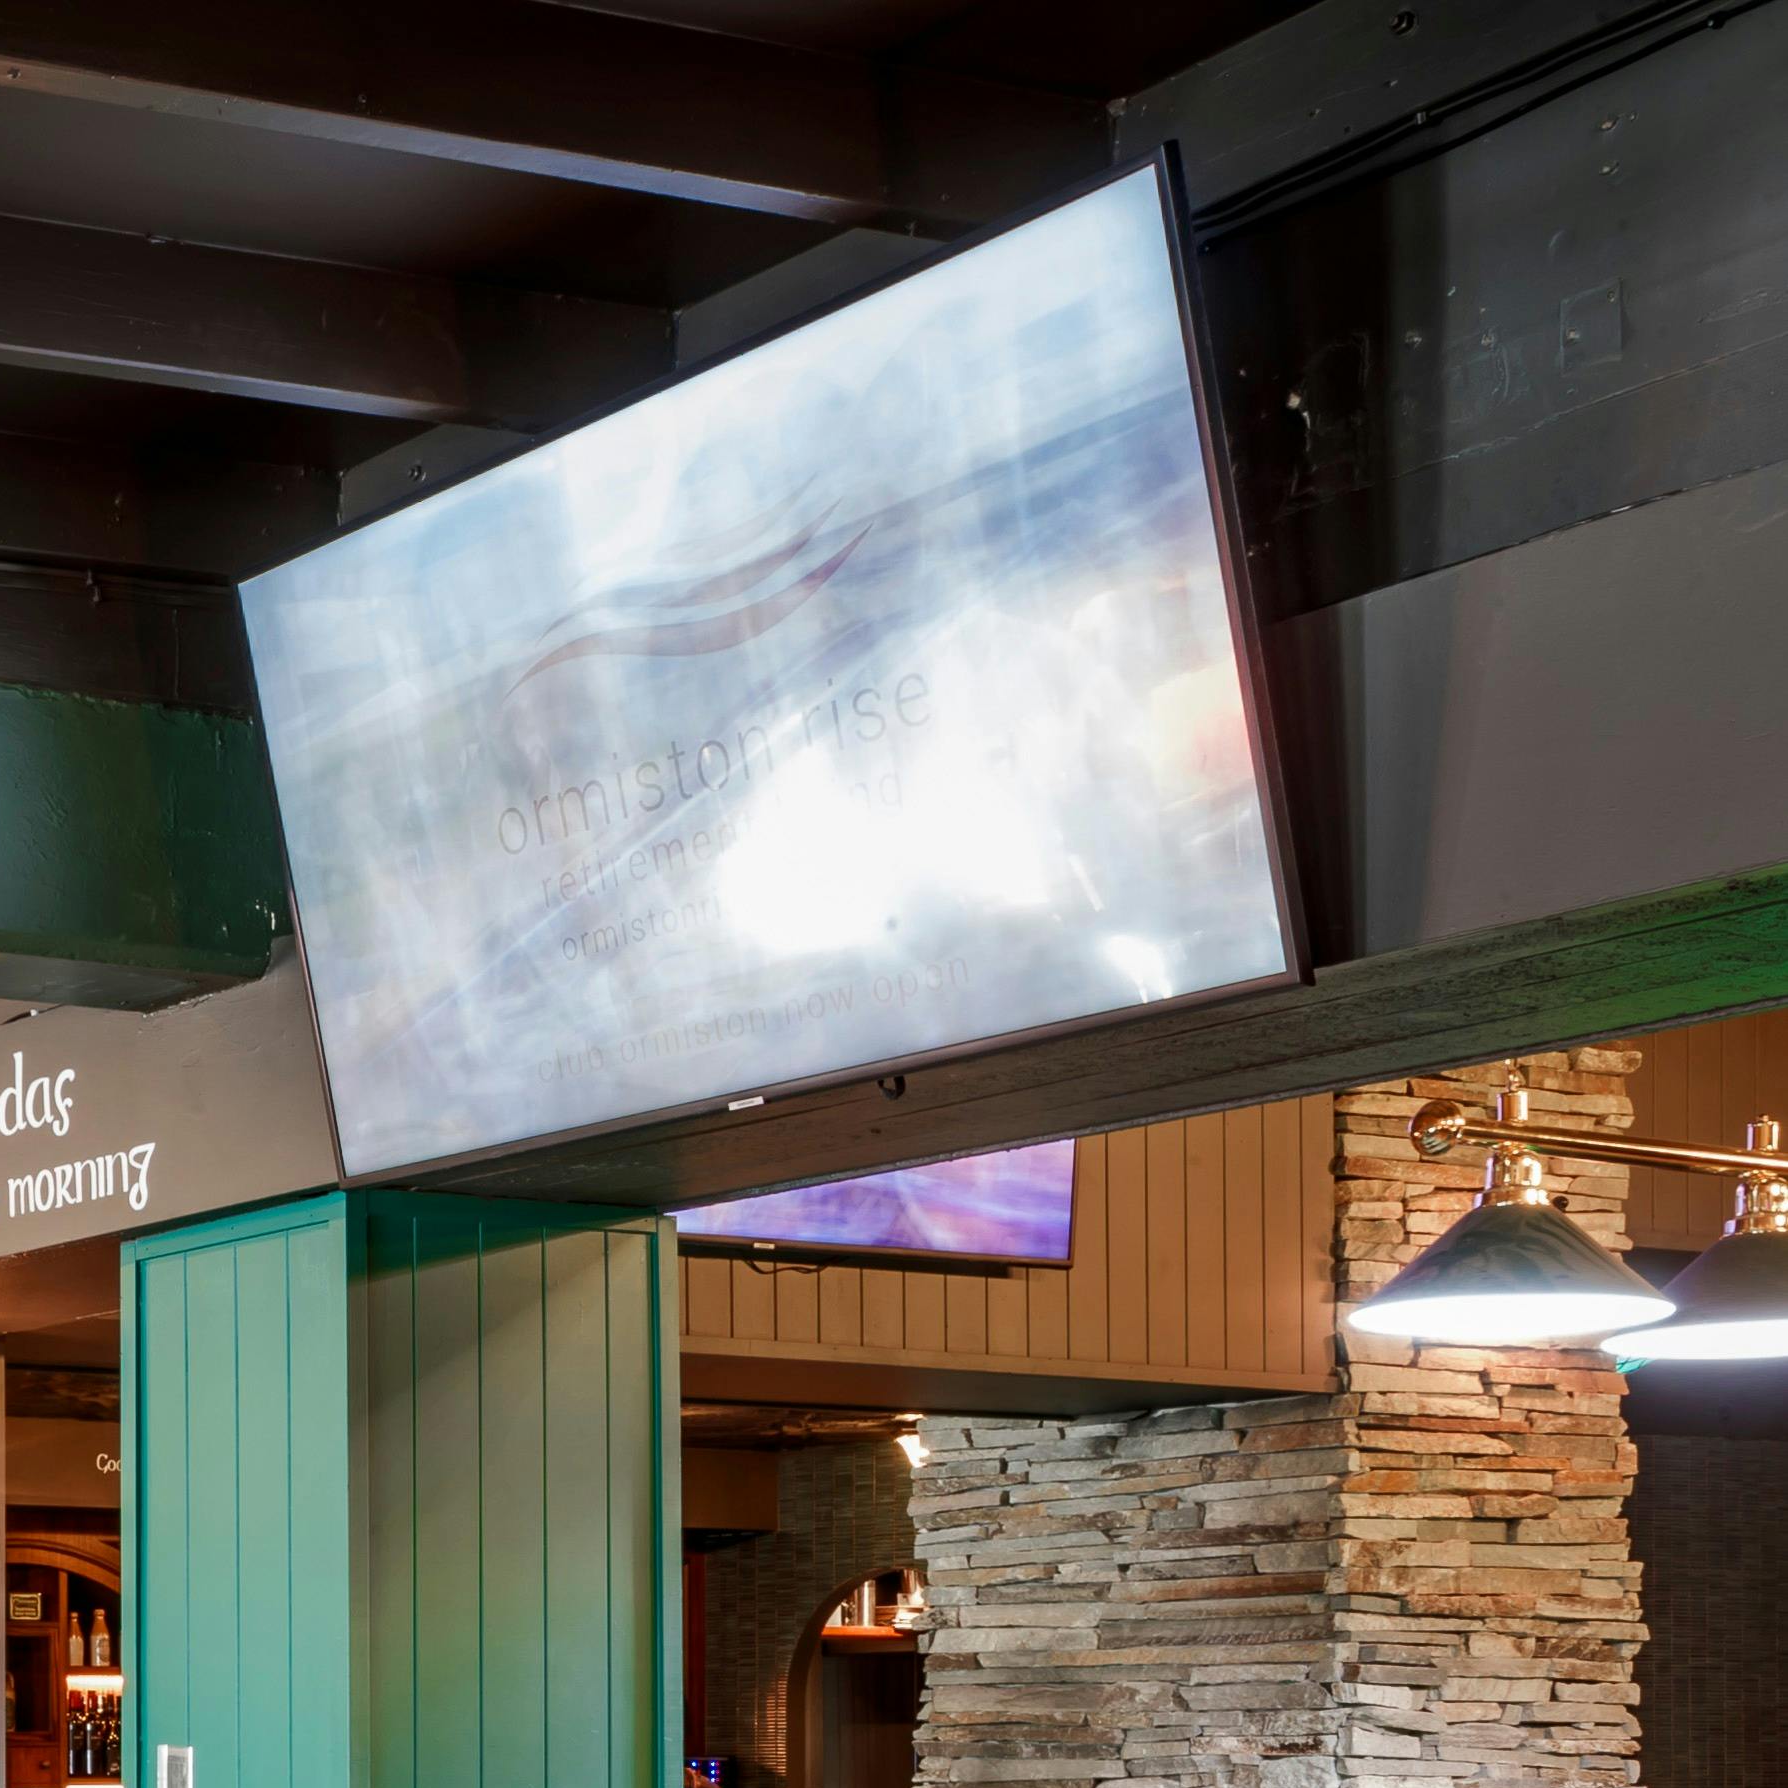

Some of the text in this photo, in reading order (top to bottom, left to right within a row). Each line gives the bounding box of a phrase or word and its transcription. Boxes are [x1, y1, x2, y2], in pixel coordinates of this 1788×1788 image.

[497, 671, 932, 856] ormiston rise
[622, 1007, 769, 1064] ormiston
[784, 987, 855, 1026] now
[872, 957, 970, 1008] open
[7, 1141, 156, 1219] morning
